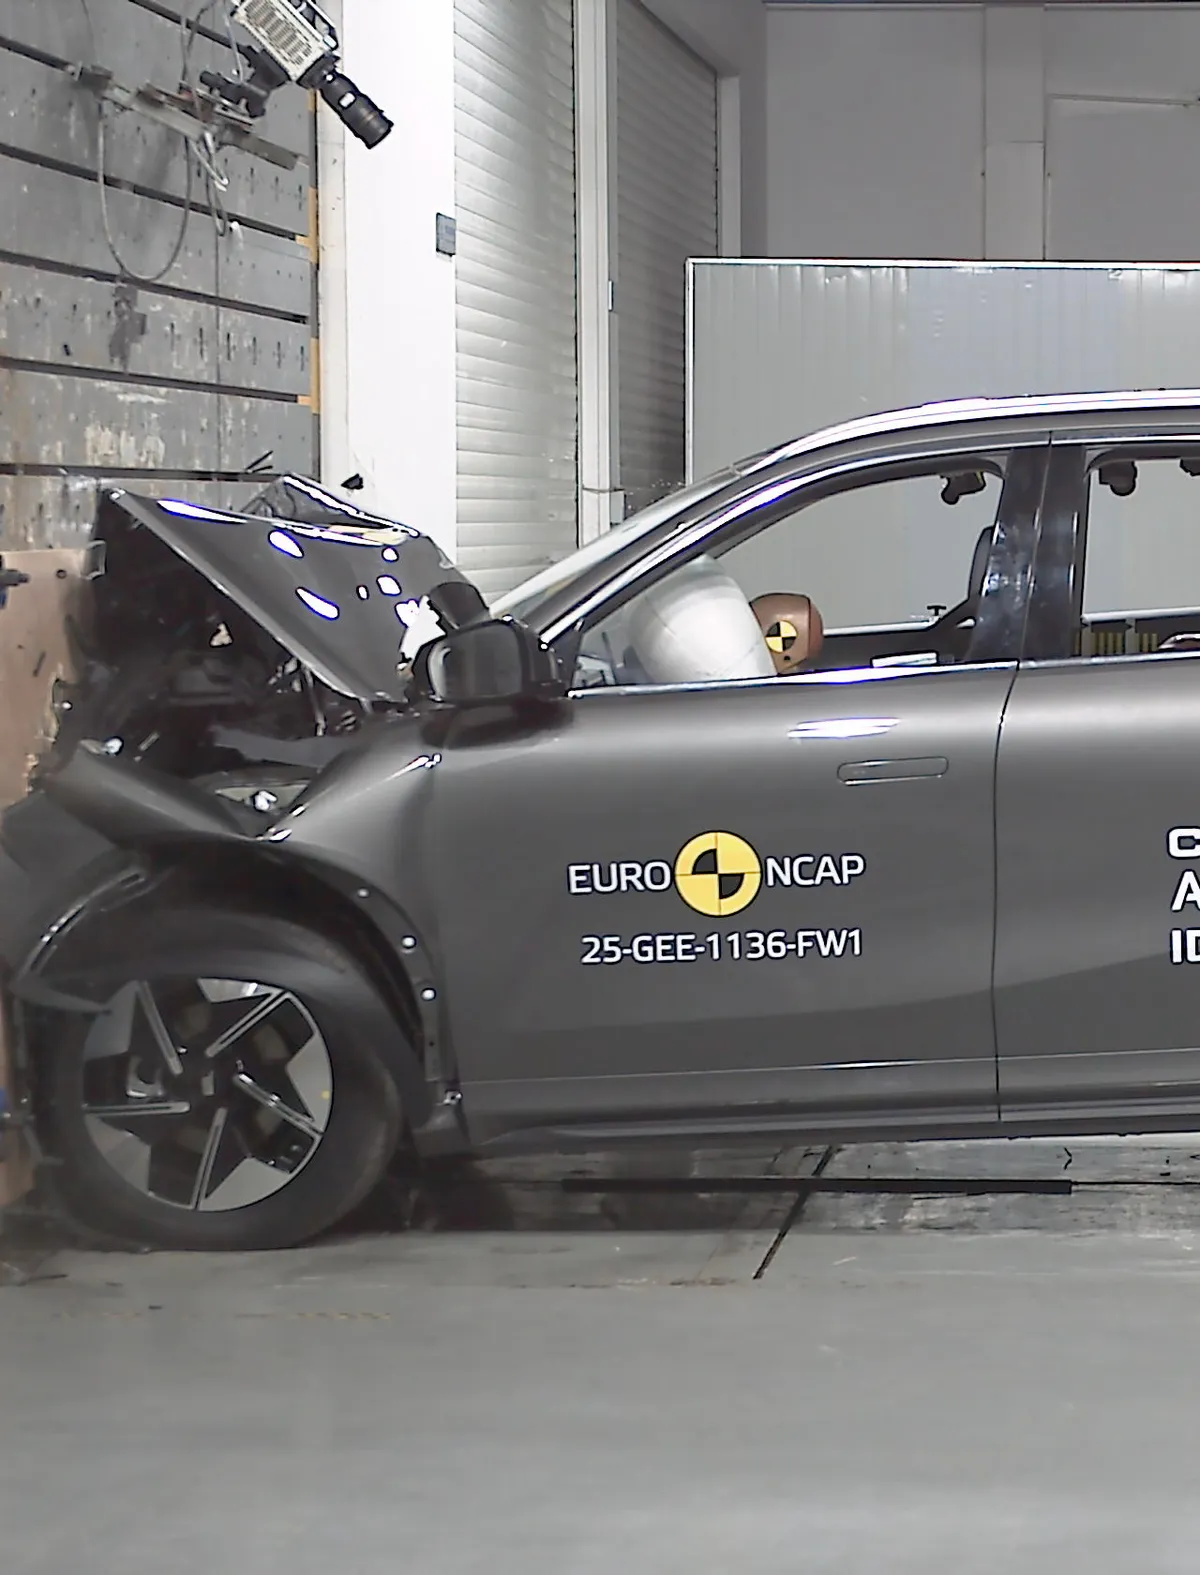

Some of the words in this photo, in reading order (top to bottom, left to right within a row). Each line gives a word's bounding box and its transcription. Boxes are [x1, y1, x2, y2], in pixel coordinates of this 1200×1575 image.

[568, 861, 671, 893] EURO
[766, 855, 864, 886] NCAP
[581, 929, 860, 963] 25-GEE-1136-FW1
